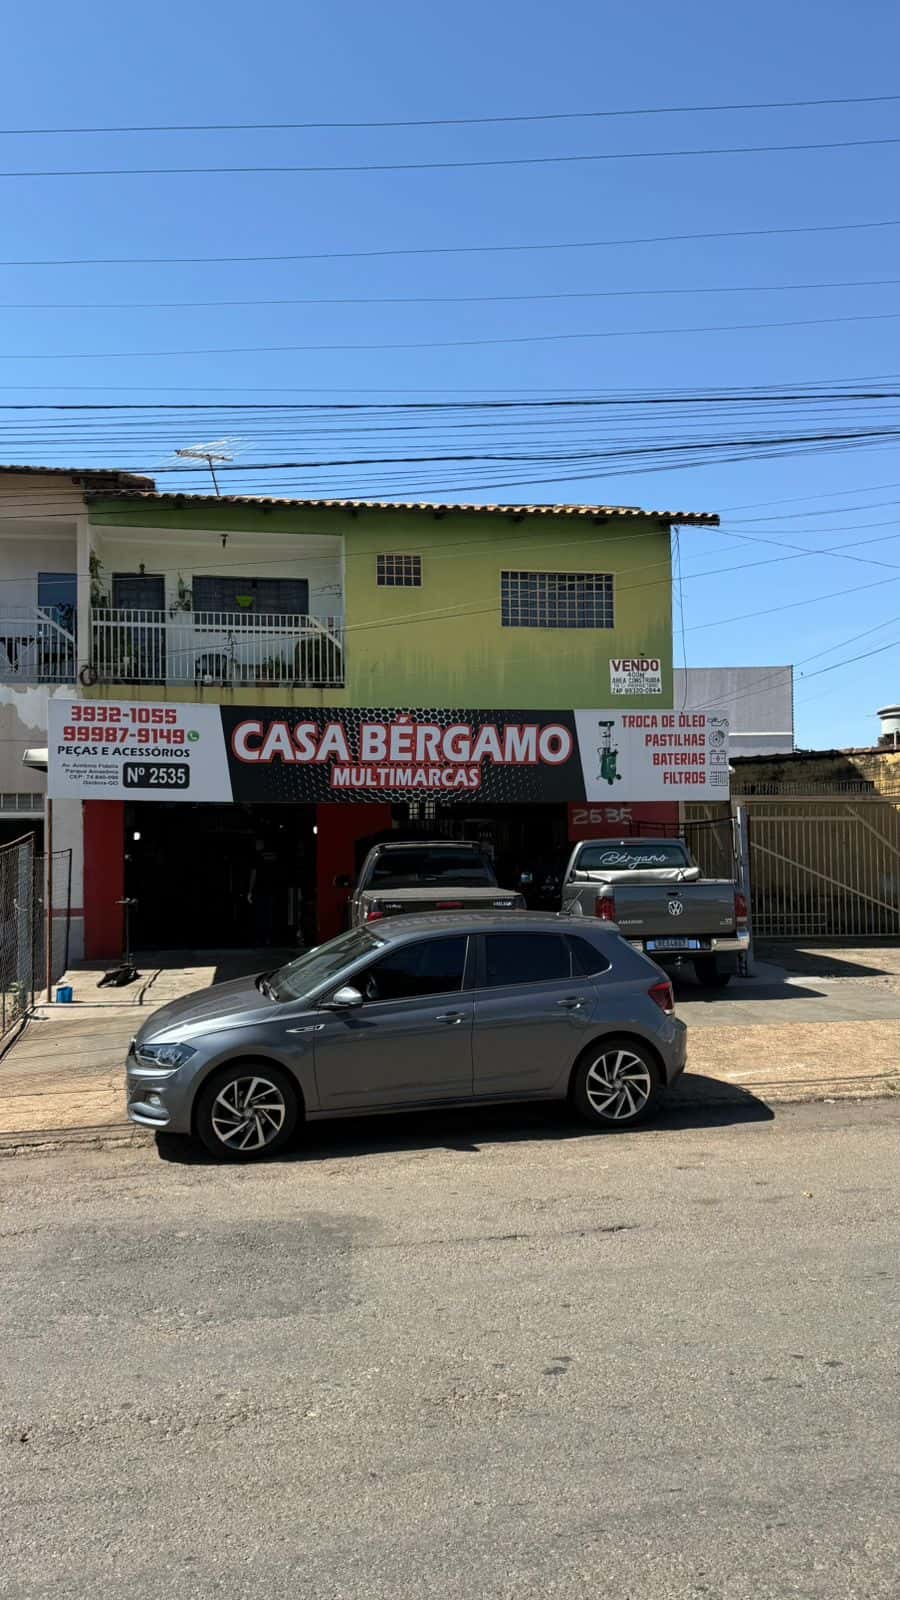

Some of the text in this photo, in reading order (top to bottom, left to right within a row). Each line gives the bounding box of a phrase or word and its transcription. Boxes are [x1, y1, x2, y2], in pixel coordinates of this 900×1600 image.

[612, 660, 659, 672] VENDO
[71, 705, 177, 724] 3932-1055
[622, 711, 705, 728] TROCA DE ÓLEO
[63, 726, 185, 744] 99987-9149
[233, 714, 572, 764] CASA BÉRGAMO
[645, 734, 705, 746] PASTILHAS
[57, 745, 98, 757] PEÇAS
[112, 746, 191, 758] ACESSÓRIOS
[652, 753, 705, 766] BATERIAS
[149, 768, 186, 784] 2535
[331, 766, 480, 788] MULTIMARCAS
[663, 771, 705, 784] FILTROS
[600, 851, 668, 870] Bérgamo
